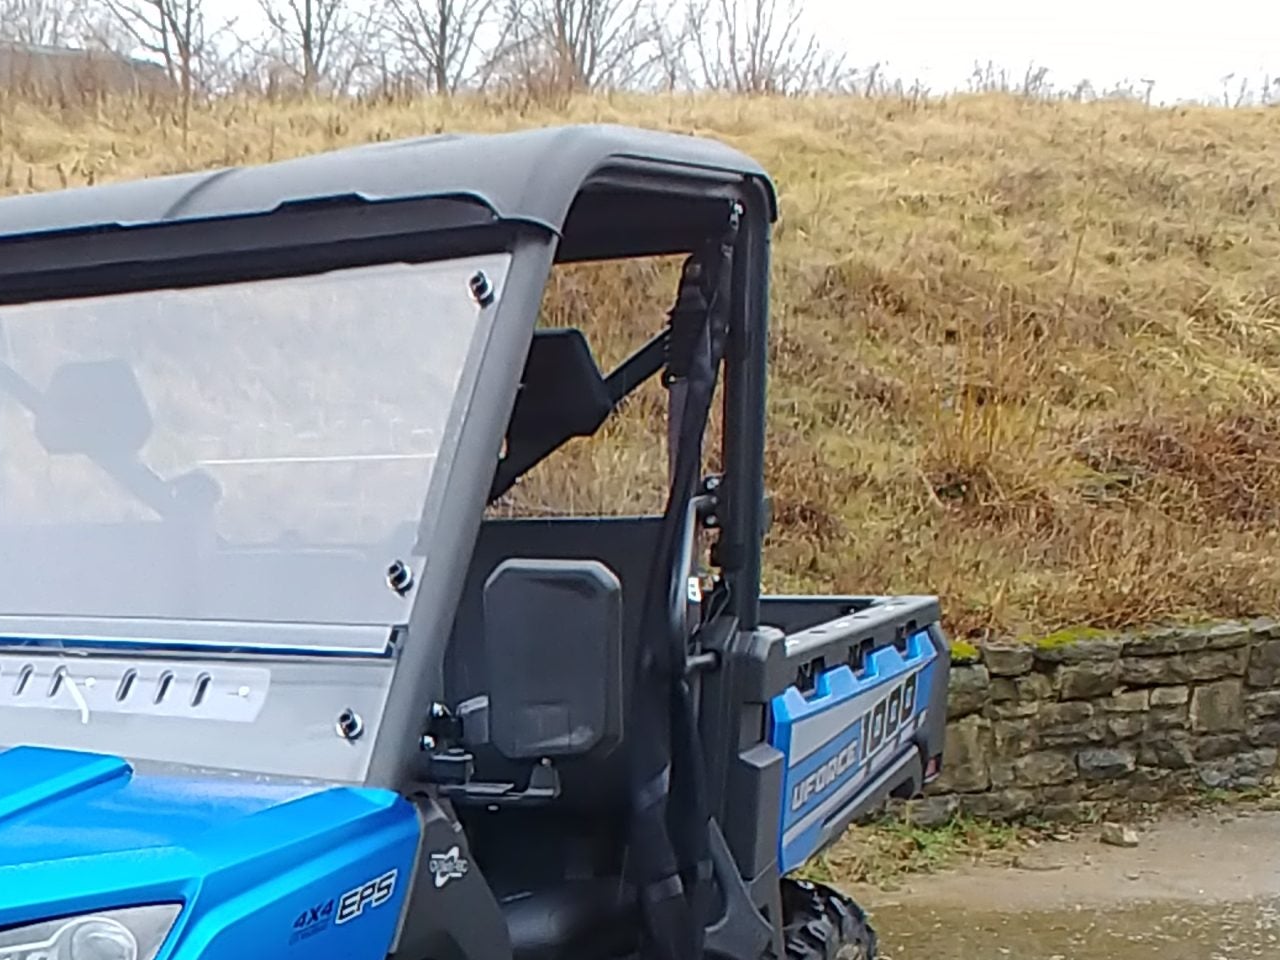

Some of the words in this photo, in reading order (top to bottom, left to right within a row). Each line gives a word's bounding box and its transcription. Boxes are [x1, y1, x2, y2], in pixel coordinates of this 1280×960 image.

[792, 740, 858, 811] UFORCE
[860, 671, 918, 764] 1000
[335, 869, 398, 924] EPS
